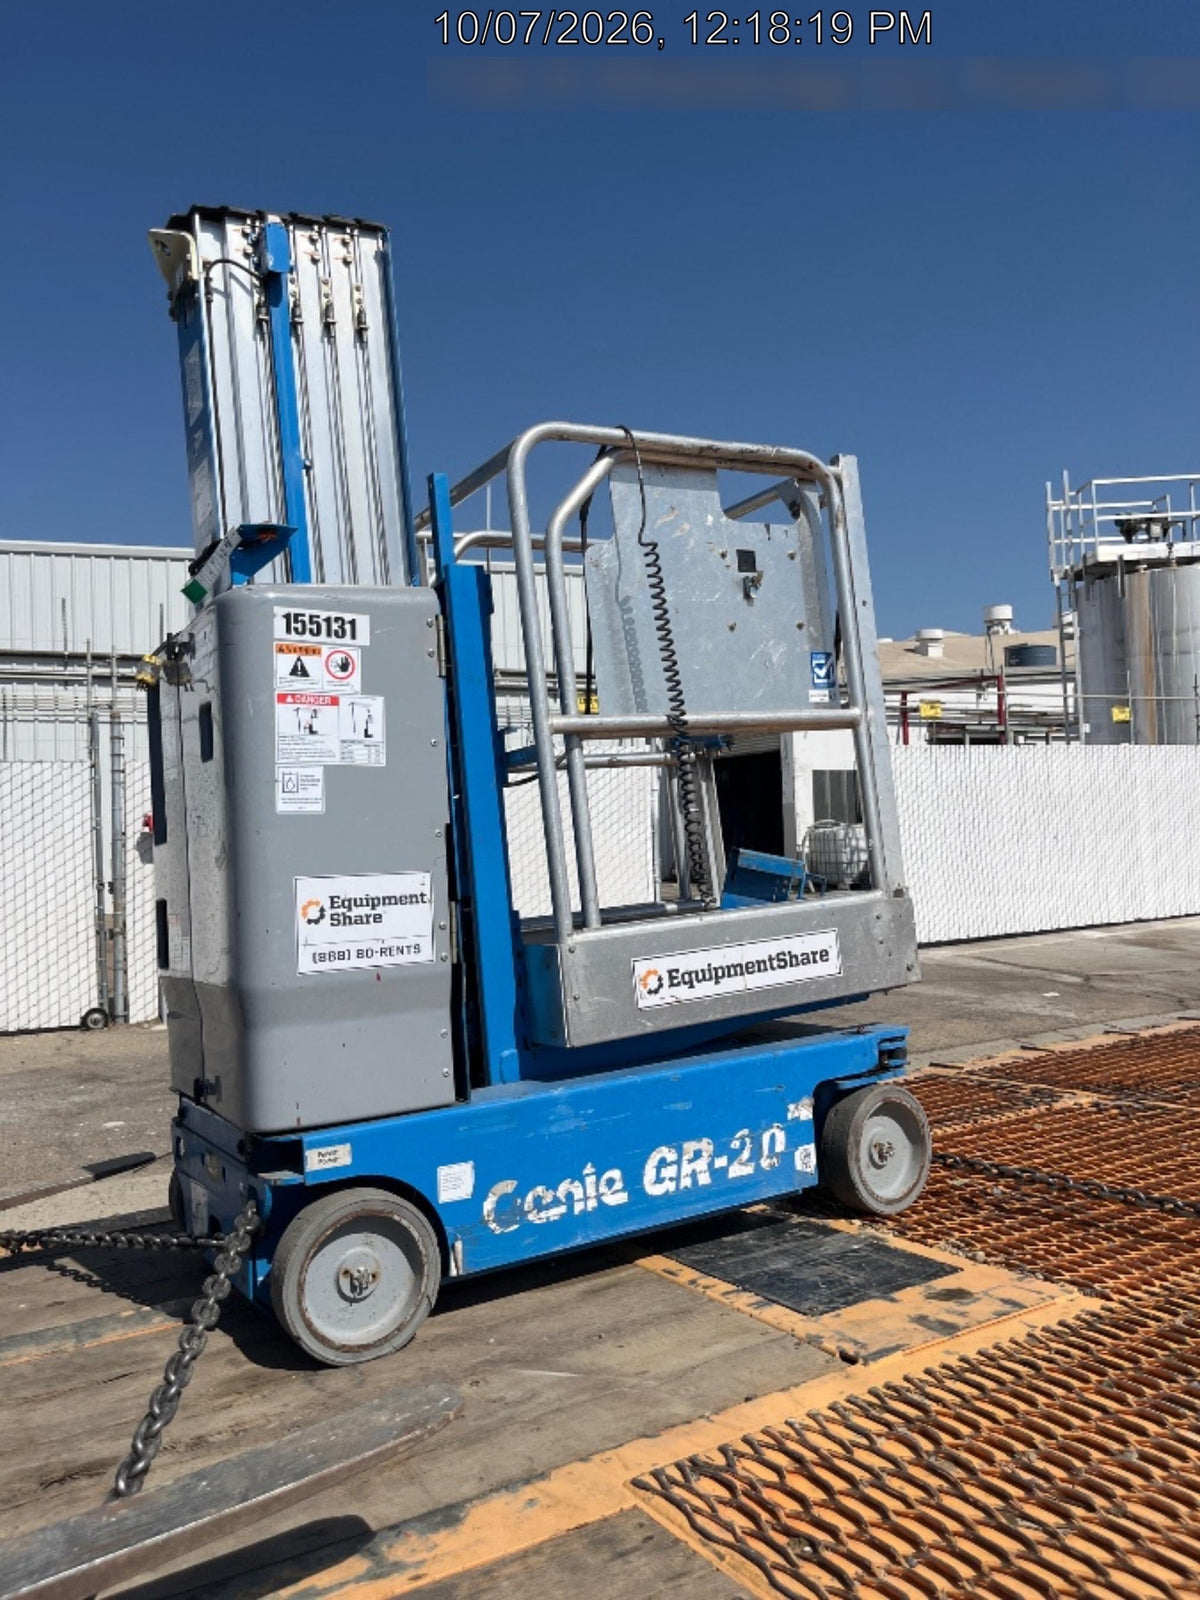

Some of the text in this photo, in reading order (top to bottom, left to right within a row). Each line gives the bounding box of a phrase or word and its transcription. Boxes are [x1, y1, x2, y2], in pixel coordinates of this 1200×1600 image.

[282, 612, 357, 641] 155131
[328, 891, 427, 912] Equipment
[329, 911, 383, 927] Share
[356, 943, 422, 960] 80-RENTS
[666, 948, 830, 989] EquipmentShare
[643, 1122, 787, 1196] GR-20
